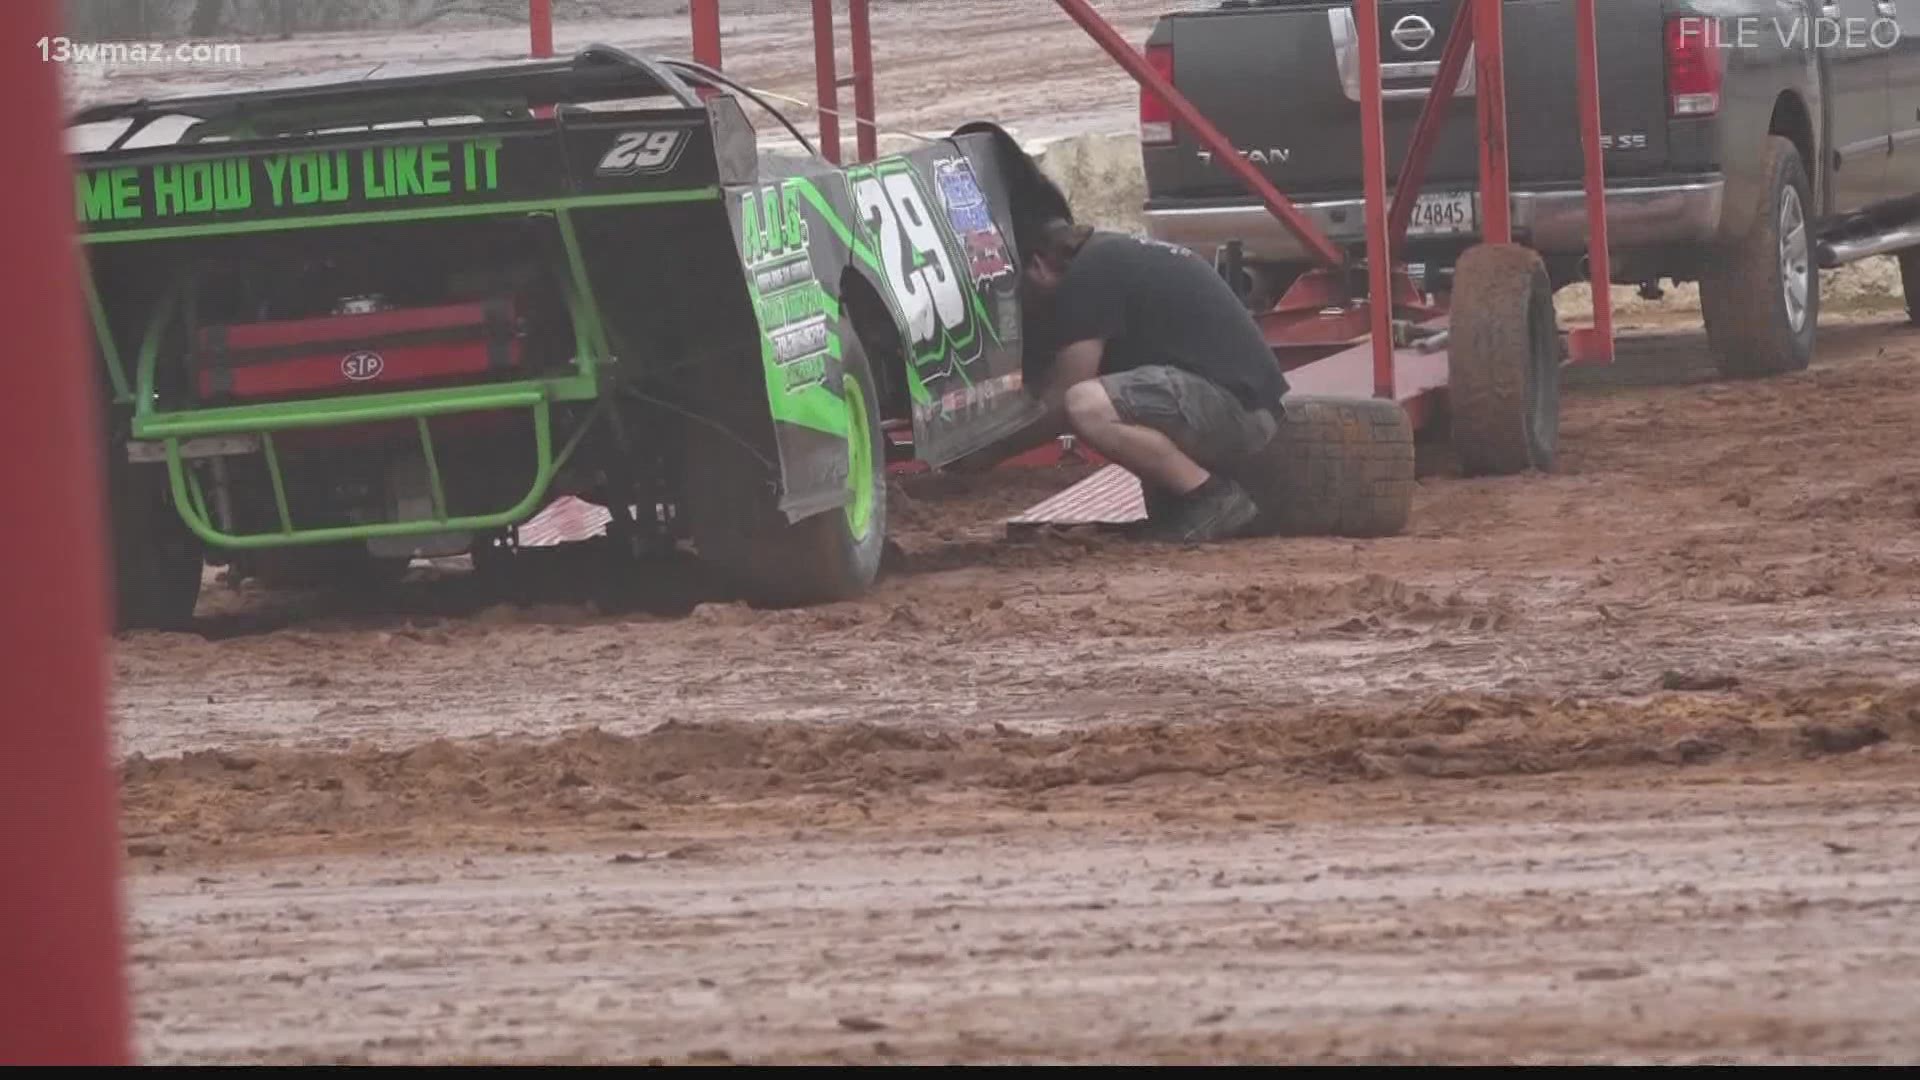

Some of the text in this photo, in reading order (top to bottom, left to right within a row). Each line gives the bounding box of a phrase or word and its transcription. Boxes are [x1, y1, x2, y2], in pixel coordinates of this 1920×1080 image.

[600, 131, 677, 170] 29
[1196, 148, 1289, 164] TAN
[77, 139, 503, 221] ME HOW YOU LIKE IT
[853, 173, 964, 344] 29
[346, 355, 378, 375] STP
